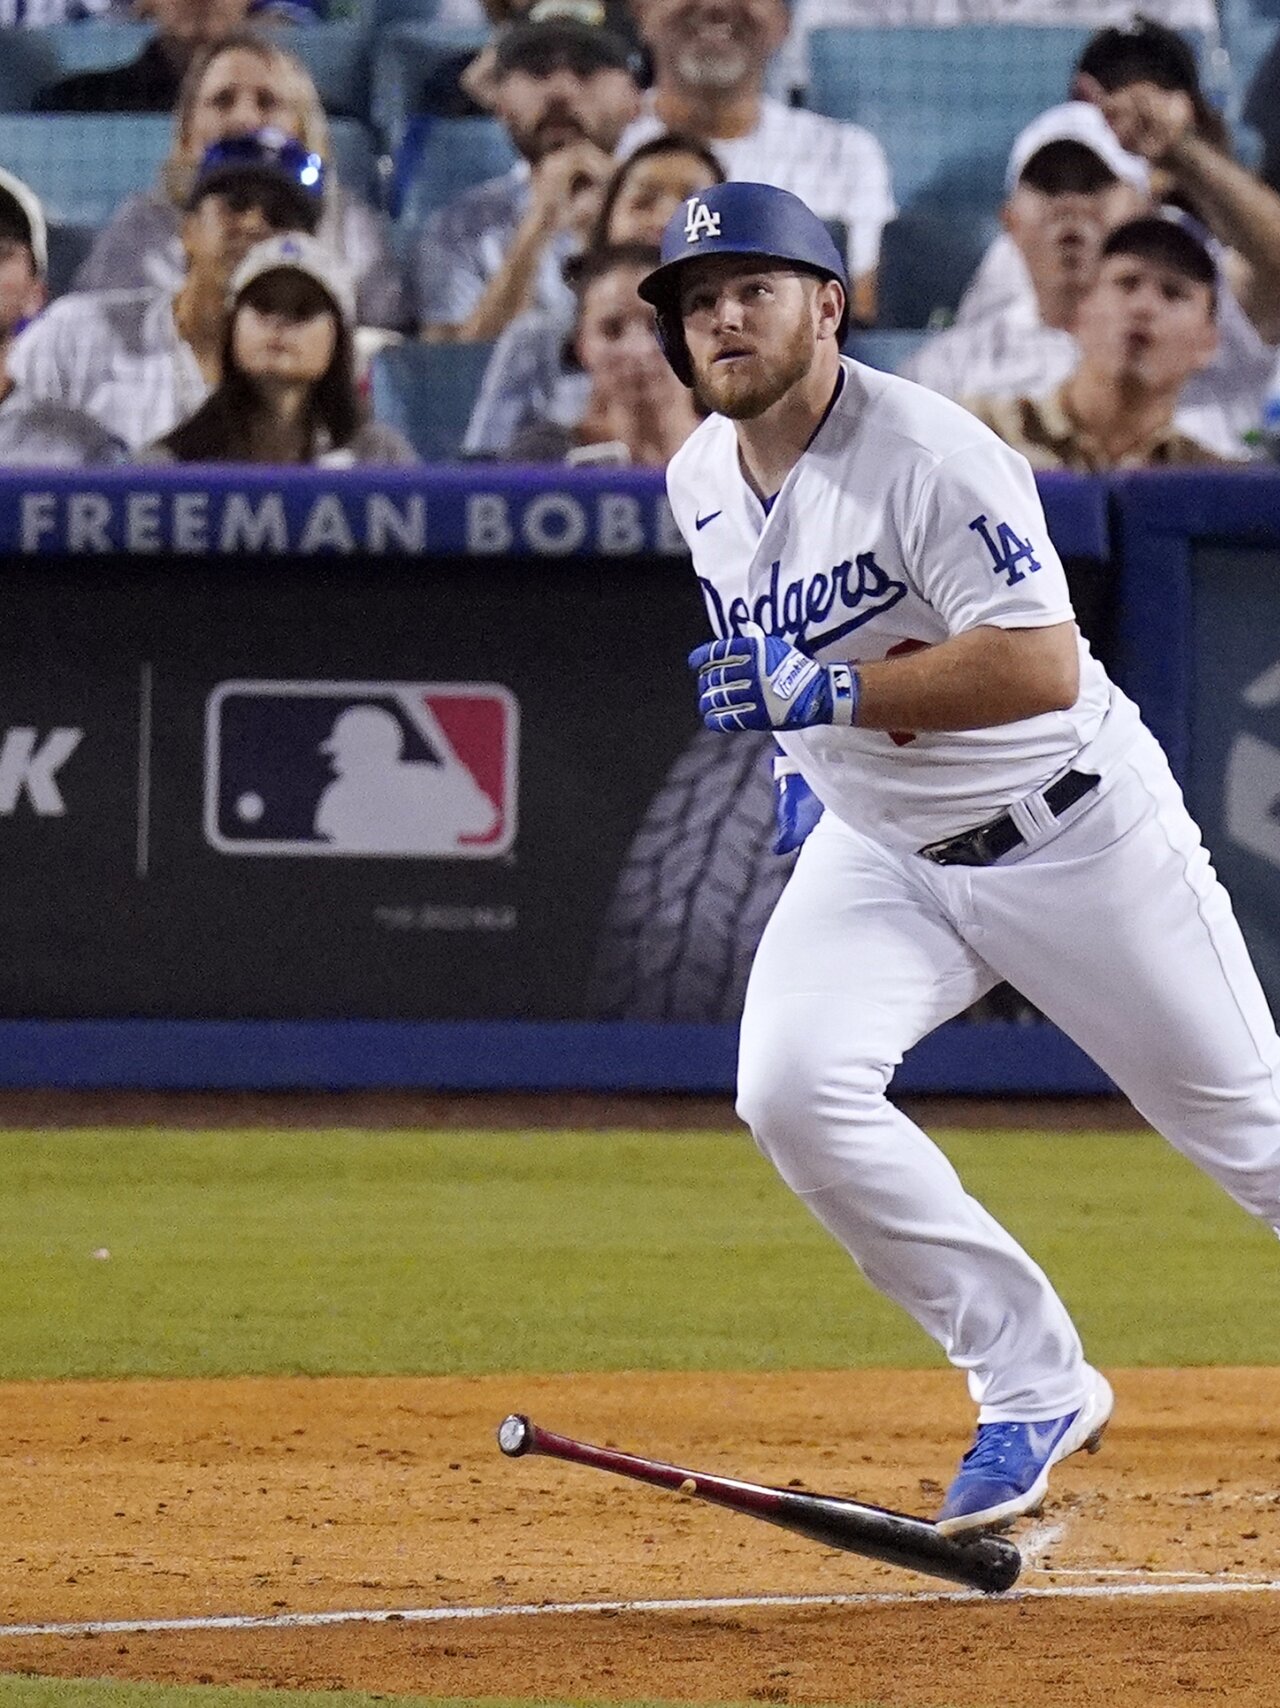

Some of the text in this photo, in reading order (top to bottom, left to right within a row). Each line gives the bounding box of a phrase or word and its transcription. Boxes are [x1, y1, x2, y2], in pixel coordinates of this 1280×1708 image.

[684, 197, 721, 243] LA
[20, 491, 427, 553] FREEMAN
[968, 514, 1042, 587] LA
[0, 726, 84, 816] K
